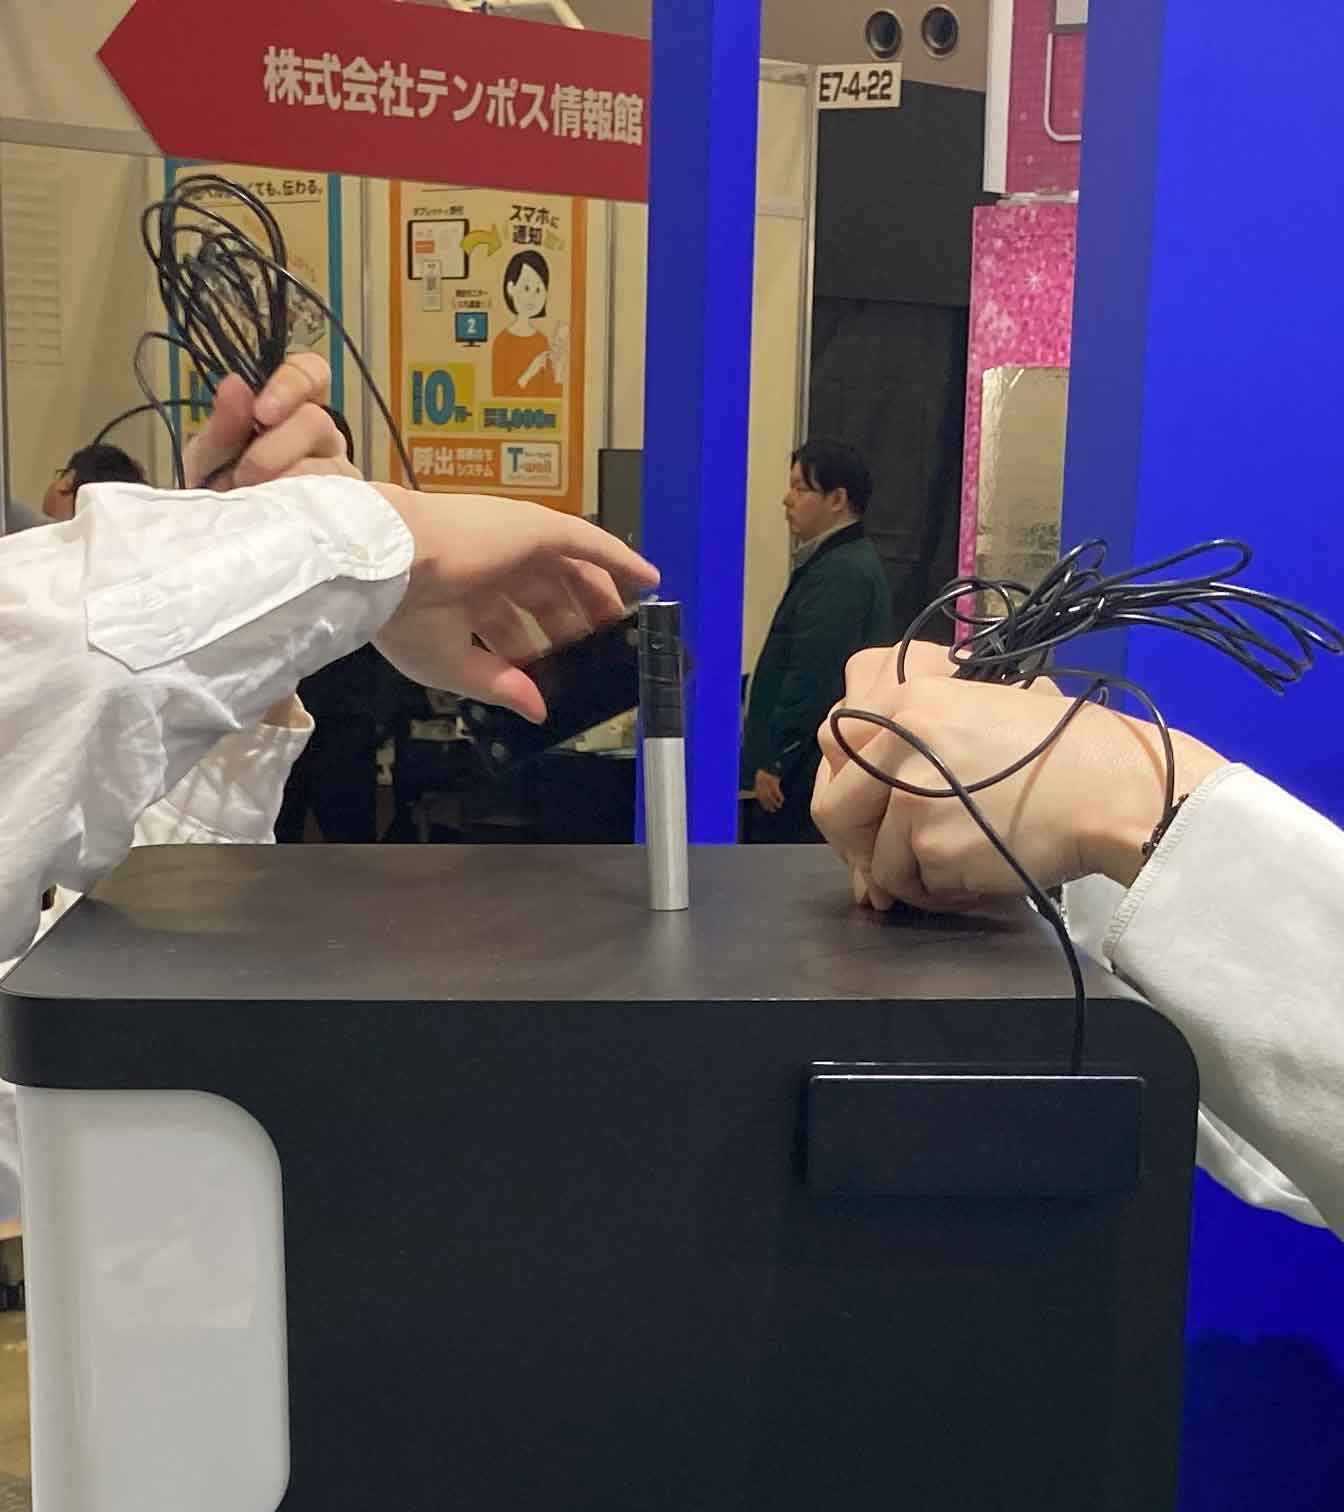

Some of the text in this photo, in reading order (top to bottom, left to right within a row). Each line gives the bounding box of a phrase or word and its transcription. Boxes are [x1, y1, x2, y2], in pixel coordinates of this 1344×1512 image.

[263, 46, 645, 146] 株式会社テンポス情報館
[818, 69, 893, 102] E7-4-22
[509, 204, 560, 229] スマホに
[512, 225, 543, 246] 通知
[466, 317, 477, 334] 2
